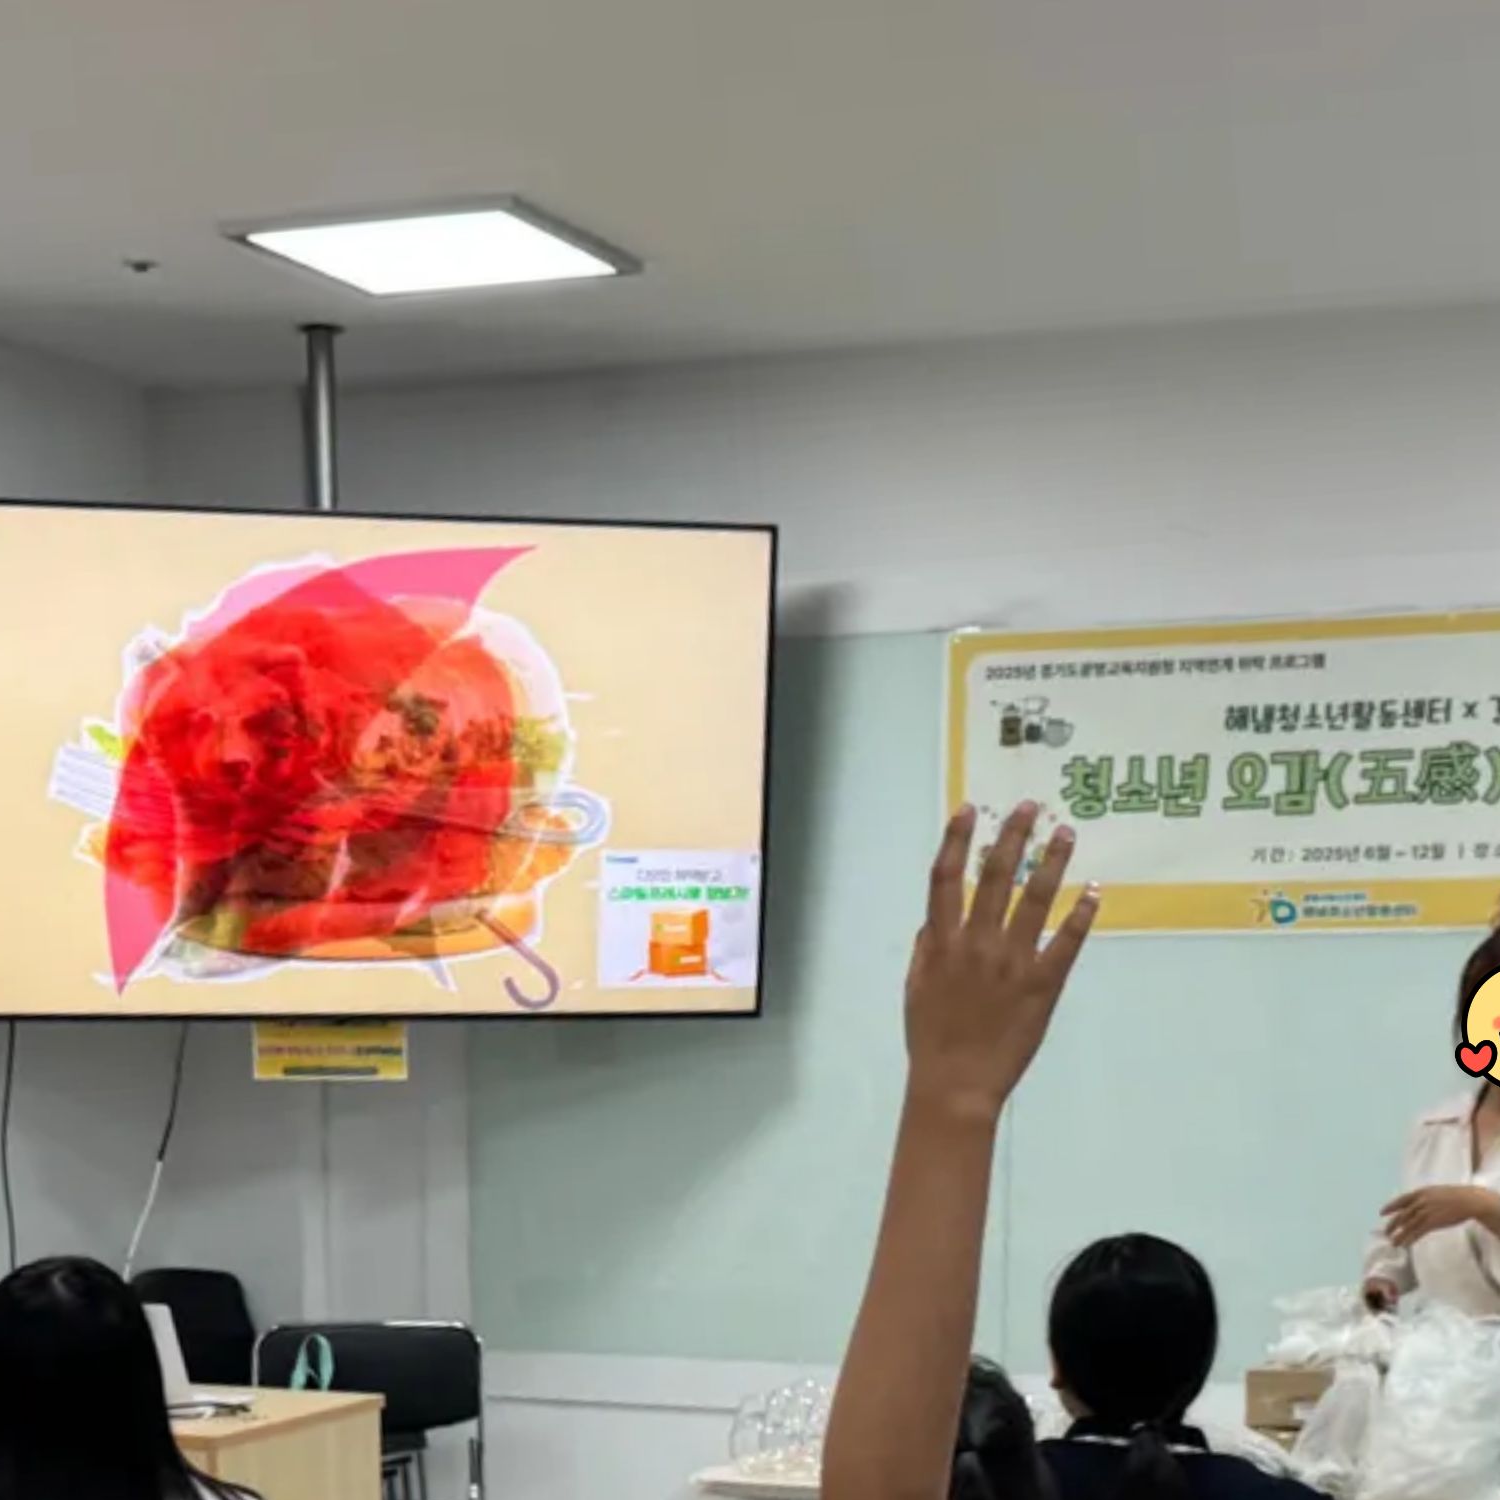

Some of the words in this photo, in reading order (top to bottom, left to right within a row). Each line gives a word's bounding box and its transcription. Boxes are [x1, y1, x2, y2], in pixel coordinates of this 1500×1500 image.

[985, 664, 1037, 681] 2025년
[1268, 652, 1326, 672] 프로그램
[1224, 696, 1453, 734] 해냄청소년활동센터
[1060, 752, 1211, 819] 청소년
[1411, 842, 1445, 861] 12월
